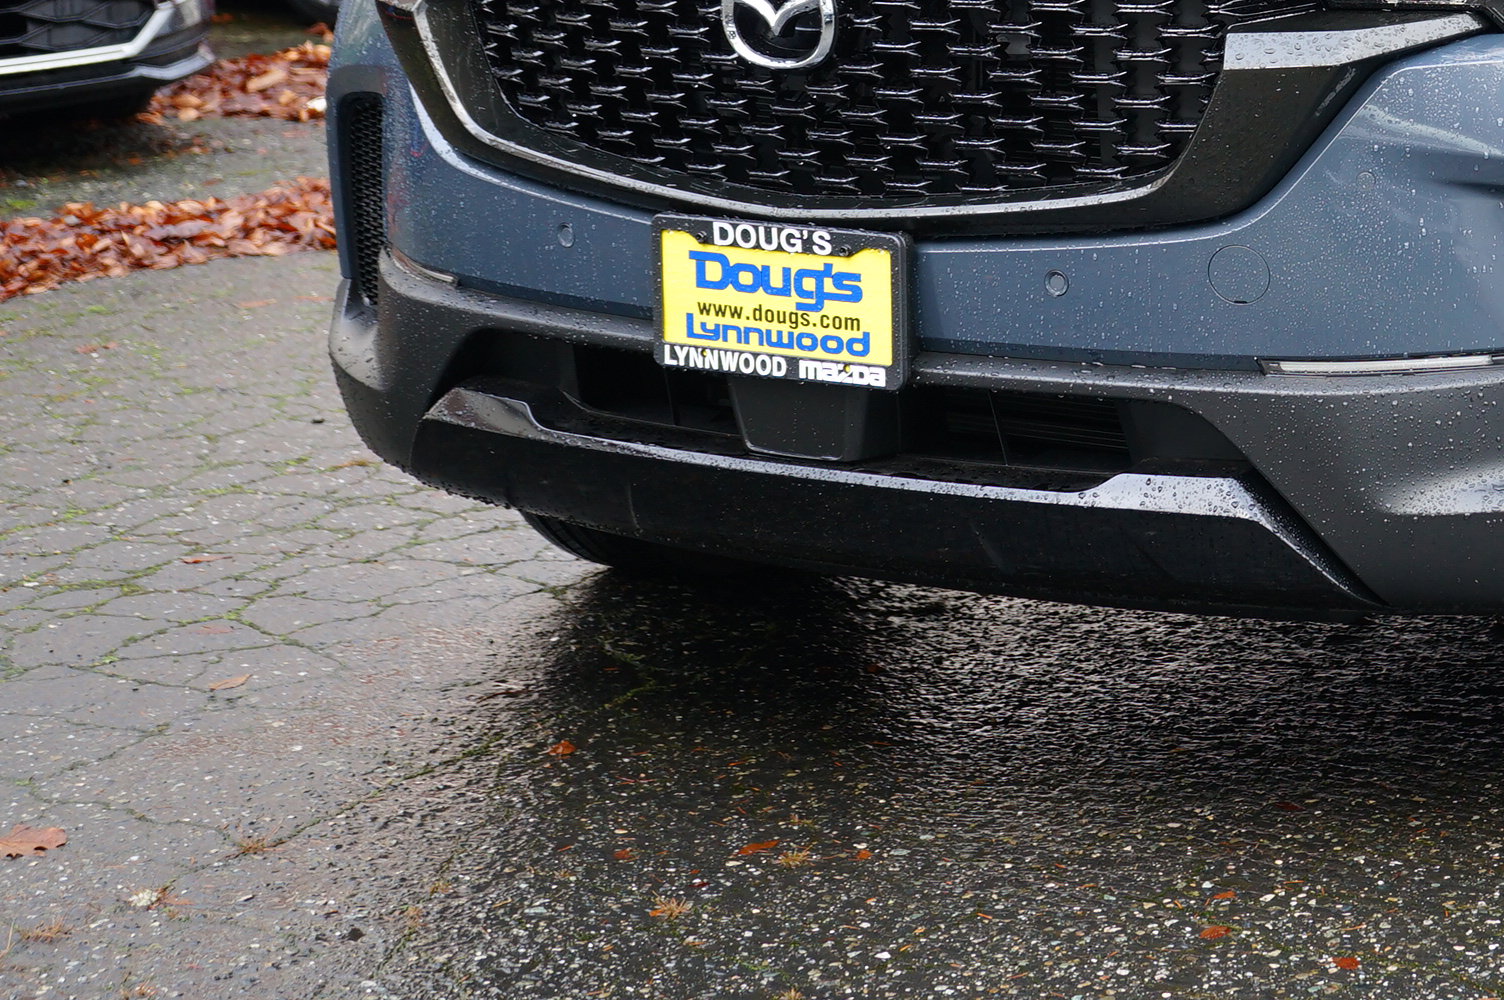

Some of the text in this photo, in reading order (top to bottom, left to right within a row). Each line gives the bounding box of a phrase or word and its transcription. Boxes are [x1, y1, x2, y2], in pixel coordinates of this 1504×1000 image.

[712, 221, 832, 256] DOUG'S
[688, 249, 863, 312] Doug's
[697, 301, 861, 331] www.dougs.com
[685, 312, 871, 357] Lynnwood
[663, 343, 787, 377] LYNNWOOD
